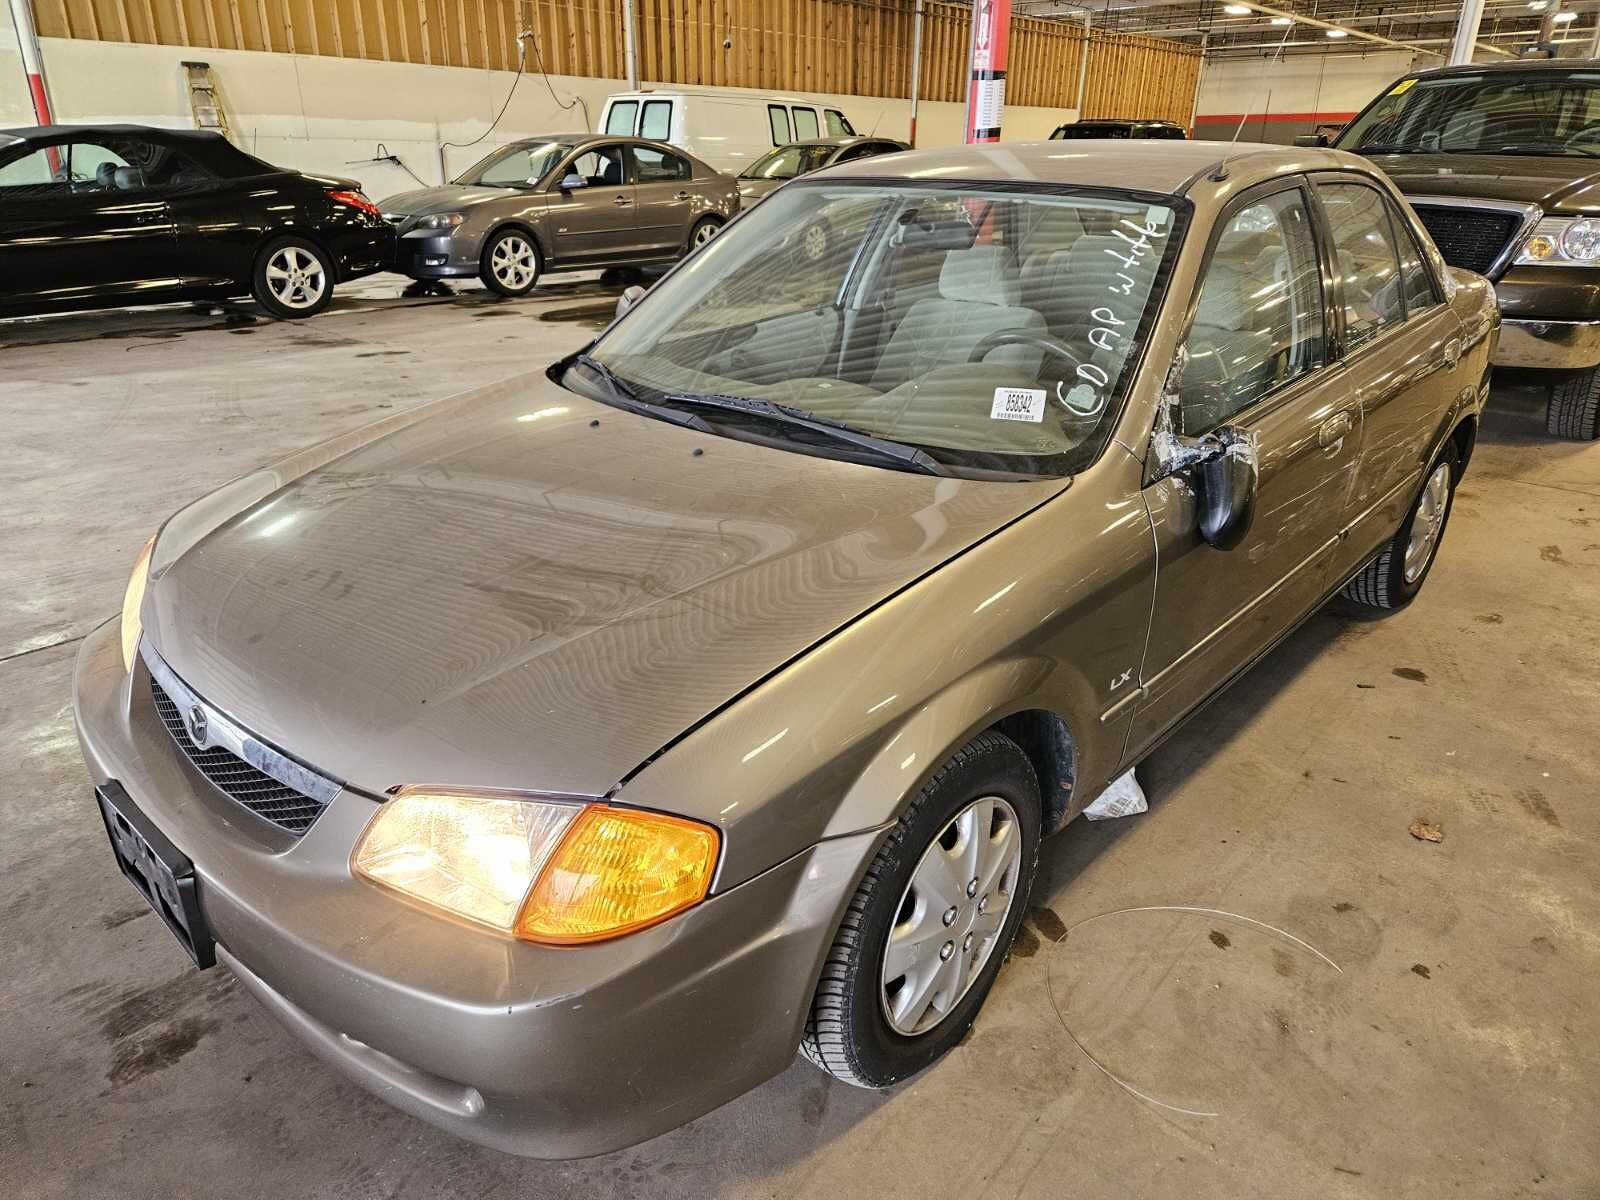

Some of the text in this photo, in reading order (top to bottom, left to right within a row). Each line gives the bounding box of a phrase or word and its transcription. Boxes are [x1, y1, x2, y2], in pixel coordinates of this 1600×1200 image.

[1057, 363, 1108, 416] CD
[1088, 307, 1125, 351] AP
[1110, 667, 1132, 690] LX
